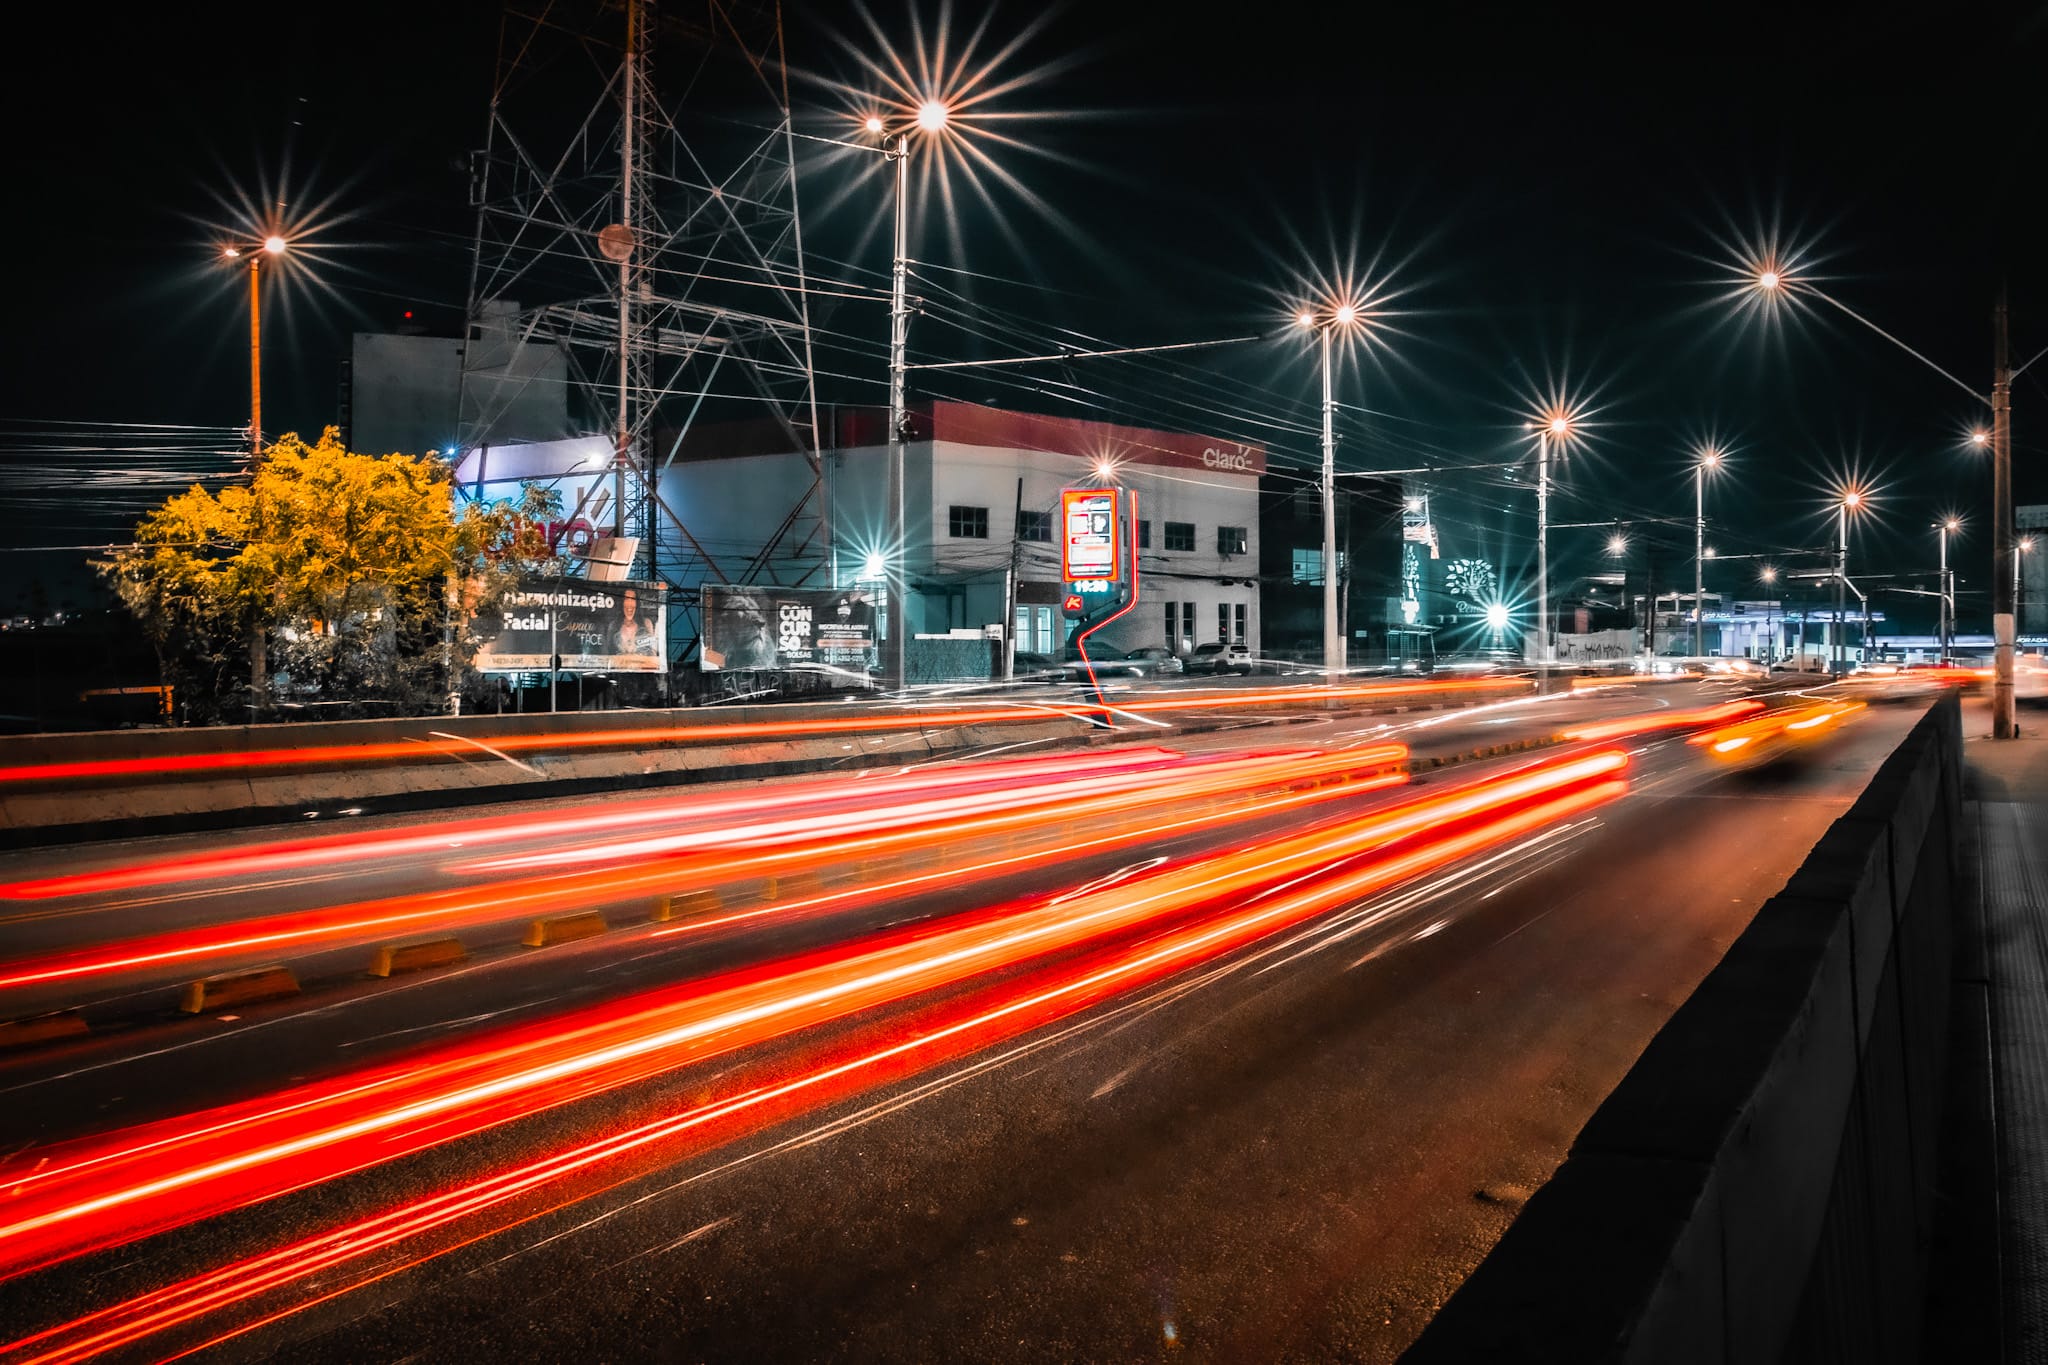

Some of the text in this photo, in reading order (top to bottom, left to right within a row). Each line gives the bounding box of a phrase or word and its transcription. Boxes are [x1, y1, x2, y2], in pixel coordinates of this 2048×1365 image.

[1203, 447, 1246, 471] Claro
[503, 588, 615, 612] Harmonização
[503, 612, 549, 631] Facial
[780, 605, 812, 621] CON
[780, 621, 811, 636] CUR
[779, 636, 801, 651] SO
